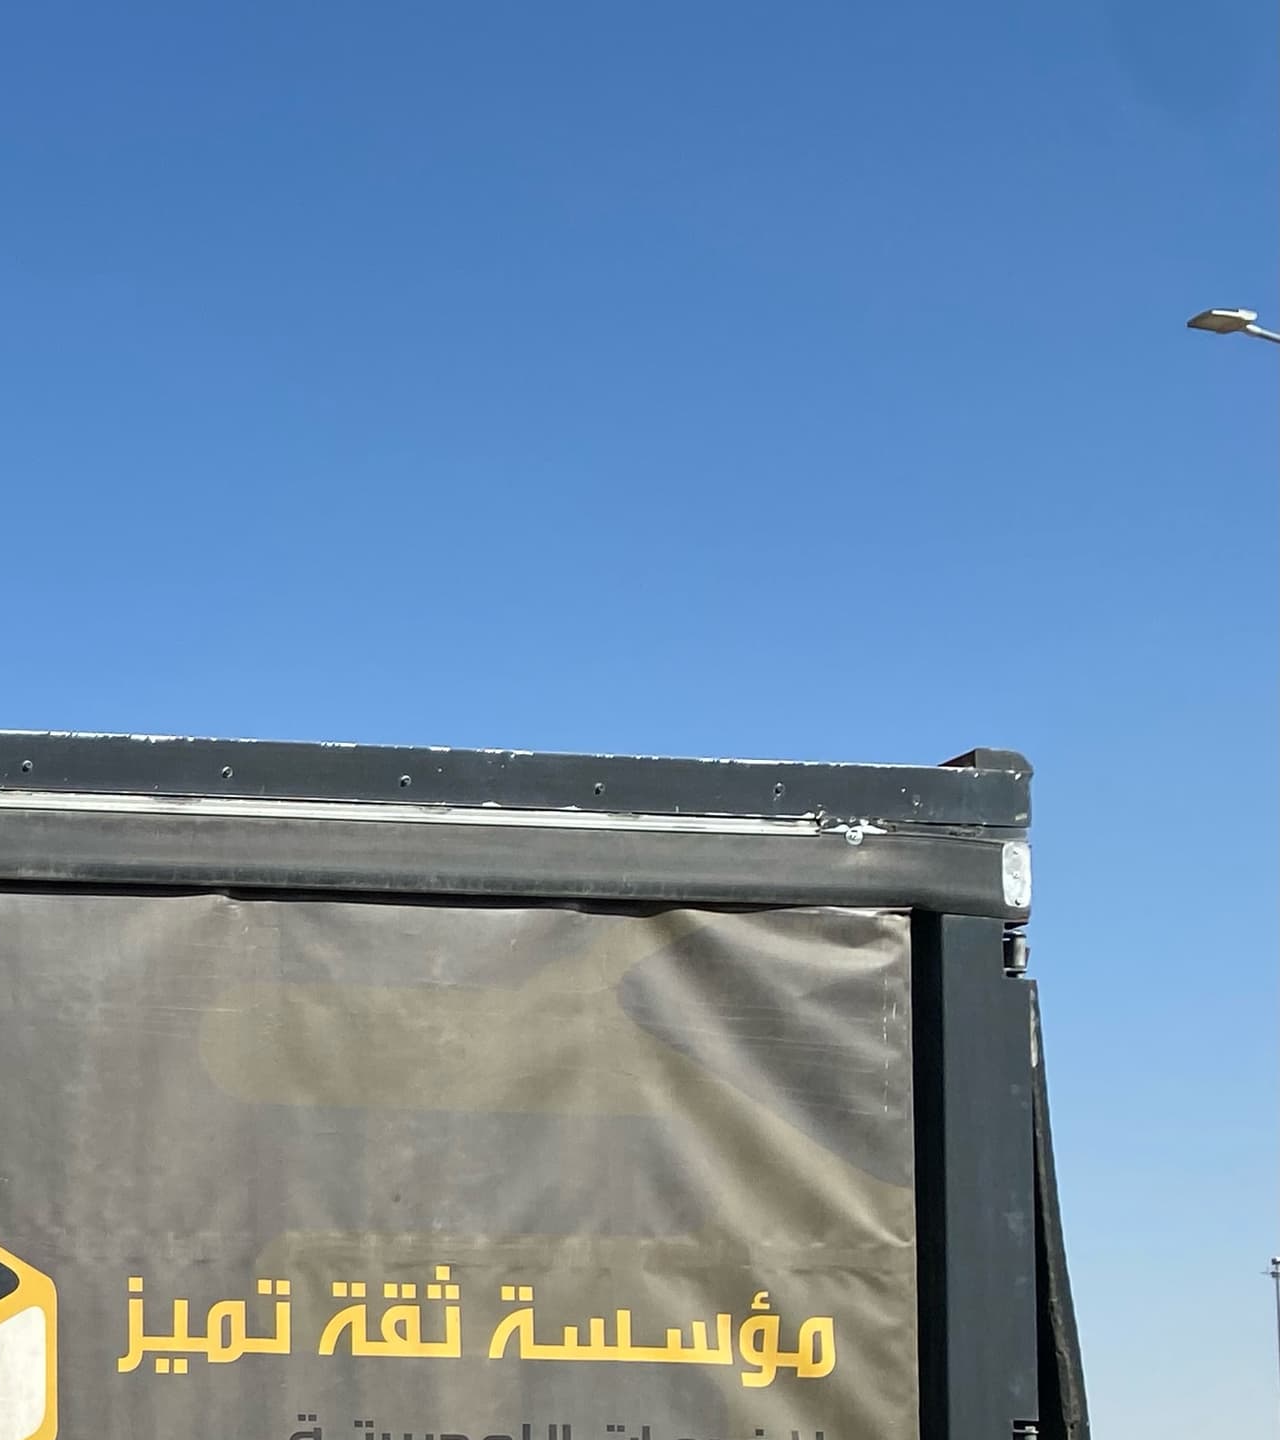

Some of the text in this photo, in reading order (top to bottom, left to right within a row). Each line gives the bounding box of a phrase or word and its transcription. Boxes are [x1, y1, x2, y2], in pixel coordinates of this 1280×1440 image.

[117, 1266, 834, 1386] مؤسسة ثقة تميز
